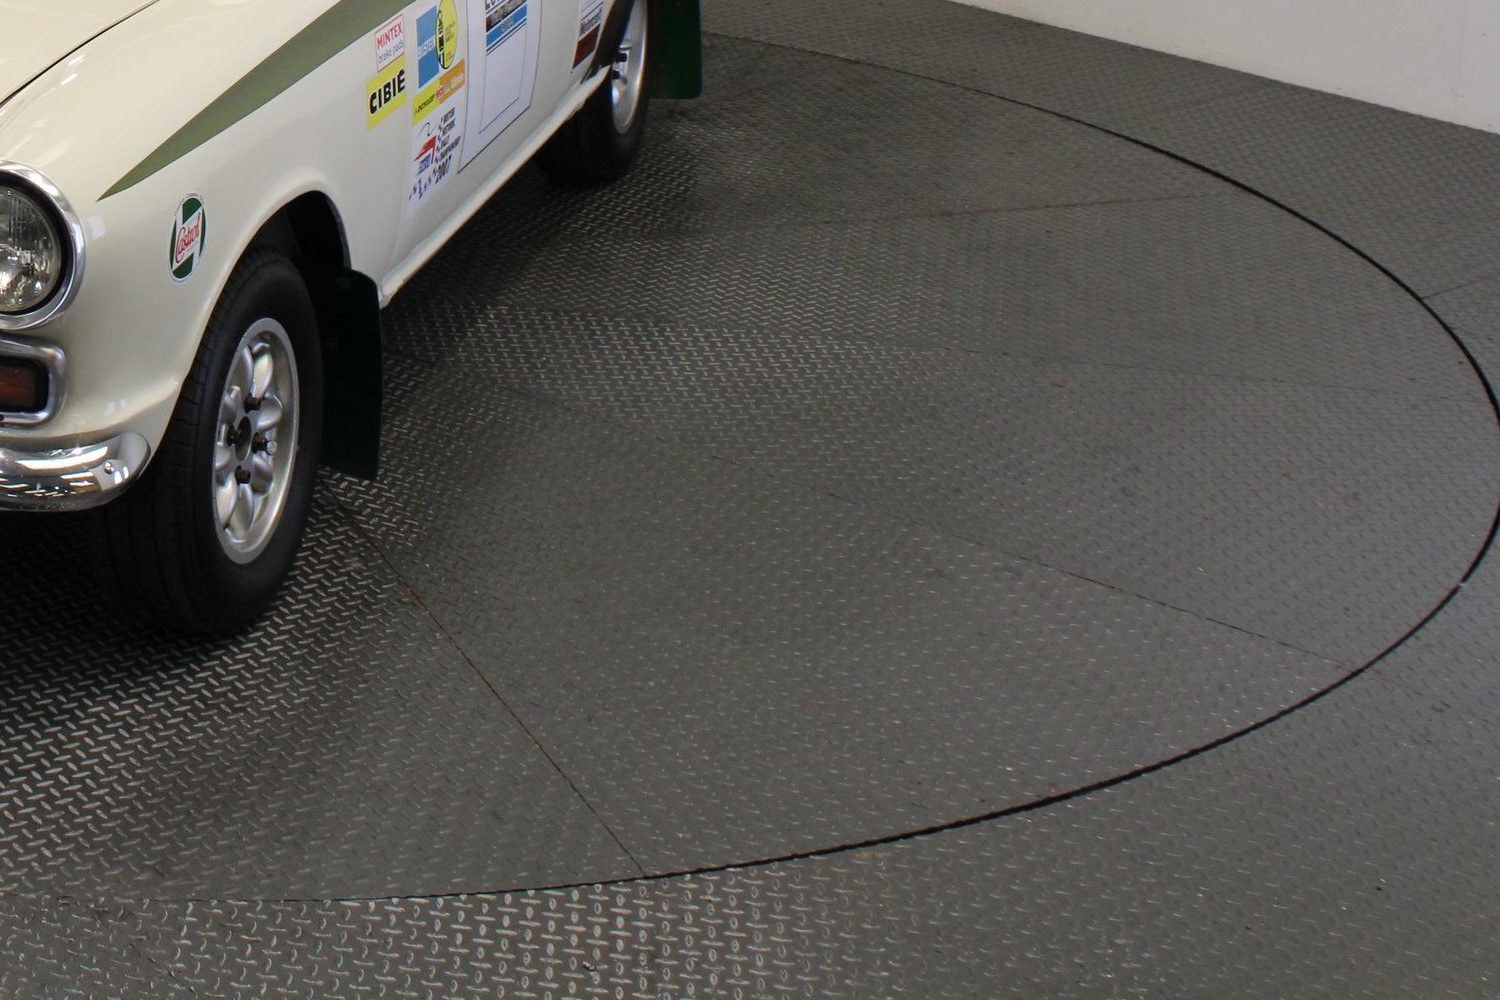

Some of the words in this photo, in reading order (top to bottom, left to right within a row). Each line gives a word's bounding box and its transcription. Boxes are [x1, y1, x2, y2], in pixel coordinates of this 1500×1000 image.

[377, 21, 403, 51] MINTEX
[378, 49, 393, 65] brake
[393, 39, 405, 57] pads
[175, 211, 201, 264] Castrol
